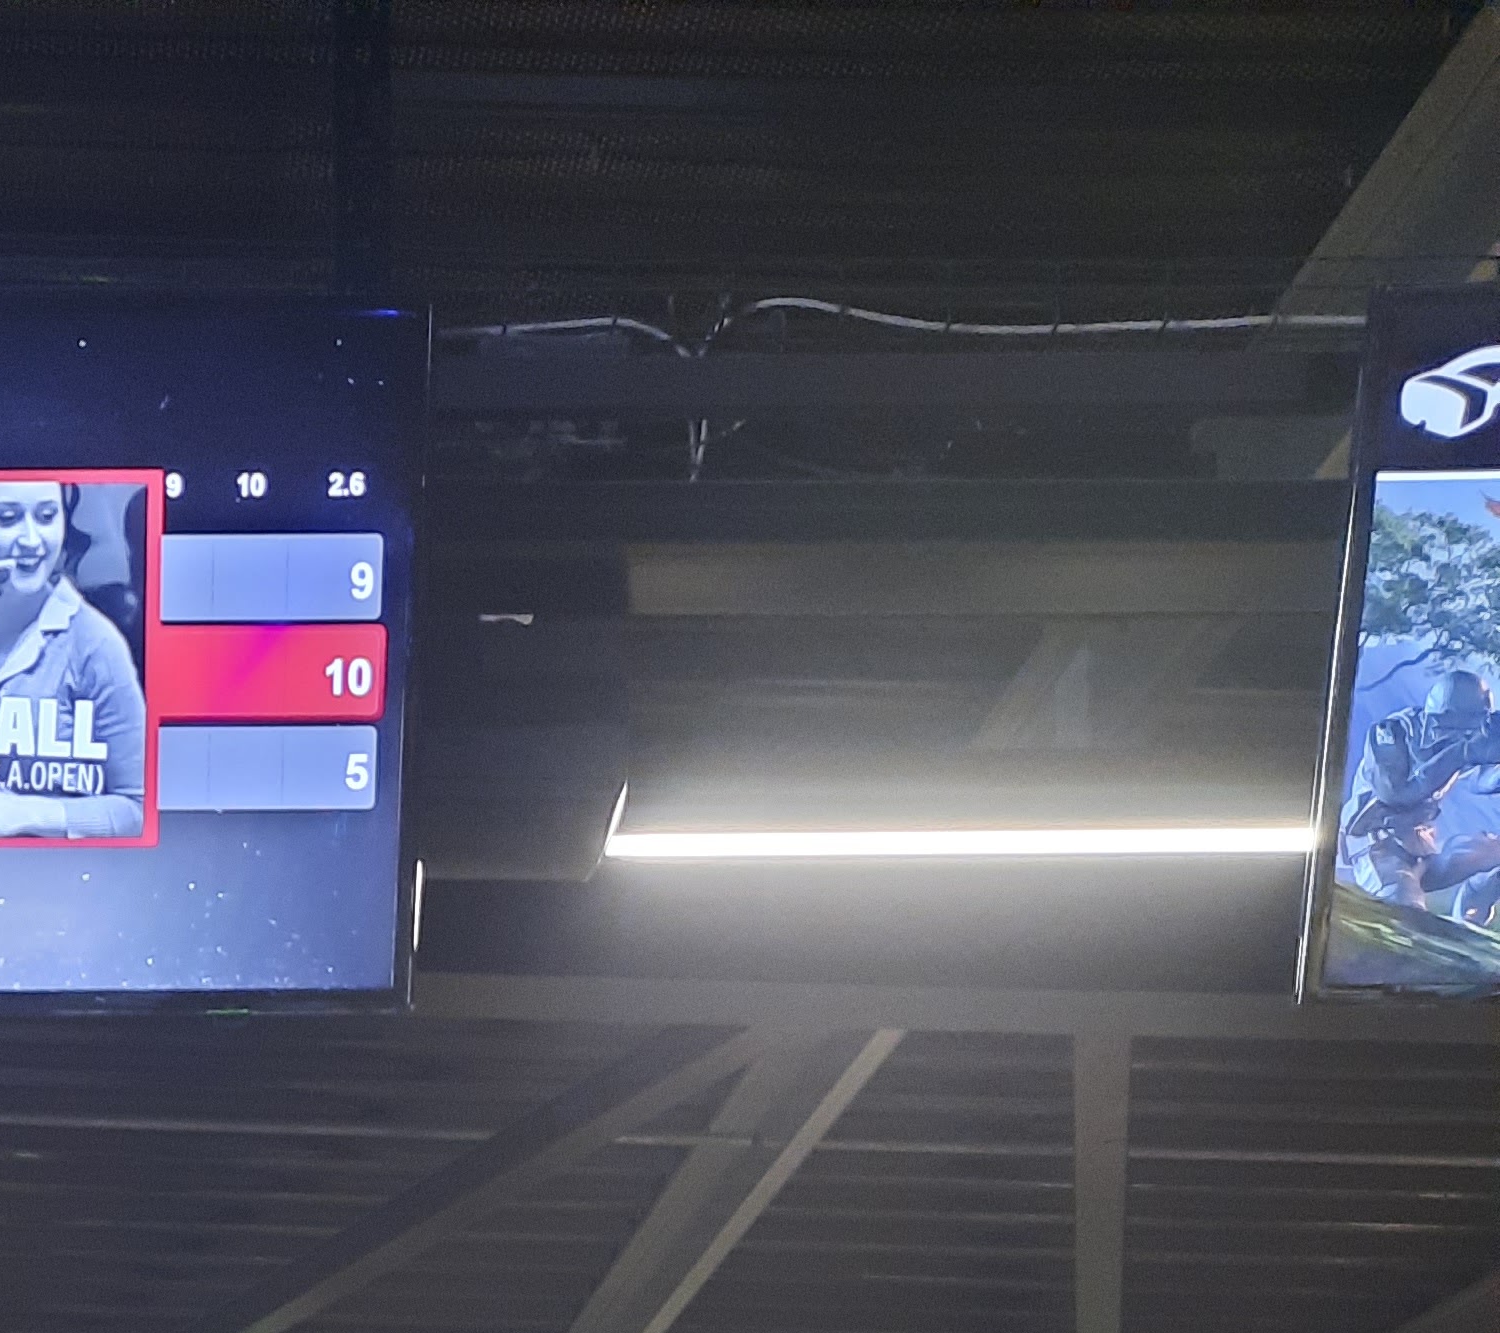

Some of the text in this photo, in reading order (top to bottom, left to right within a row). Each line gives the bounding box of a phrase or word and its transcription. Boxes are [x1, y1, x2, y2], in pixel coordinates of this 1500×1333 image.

[165, 472, 366, 499] 9 10 2.6
[350, 561, 374, 600] 9
[324, 657, 372, 696] 10
[345, 753, 368, 790] 5
